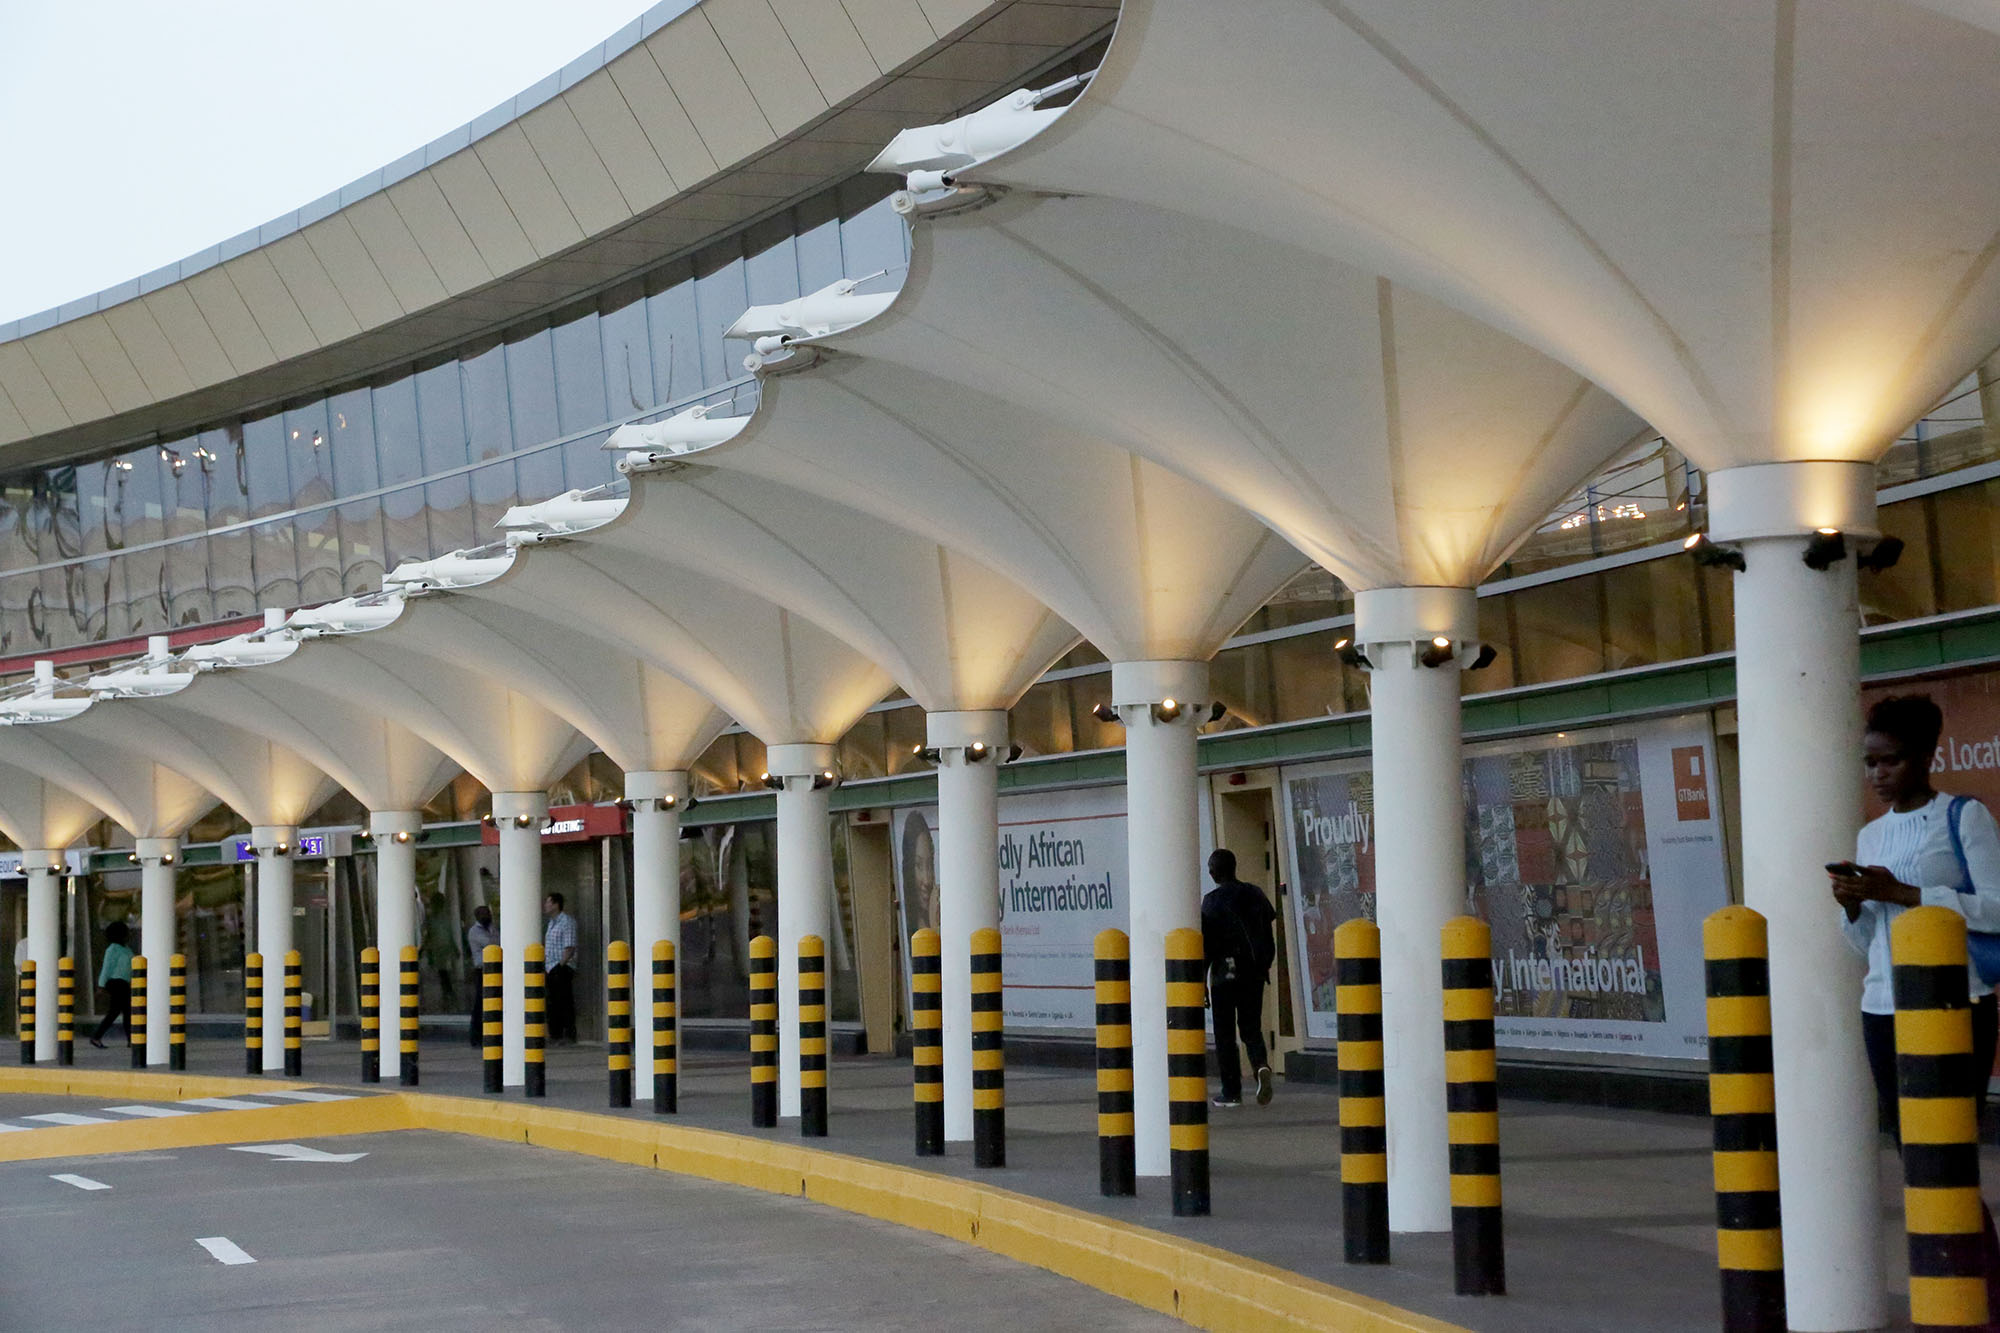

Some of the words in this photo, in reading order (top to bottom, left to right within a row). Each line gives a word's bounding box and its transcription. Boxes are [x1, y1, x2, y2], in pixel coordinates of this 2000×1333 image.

[1678, 788, 1706, 802] GTBank
[1303, 801, 1370, 855] Proudly
[999, 833, 1022, 880] dly
[1028, 830, 1085, 869] African
[999, 888, 1006, 923] y
[1010, 871, 1113, 913] International
[1491, 958, 1505, 1003] y
[1509, 944, 1647, 995] International
